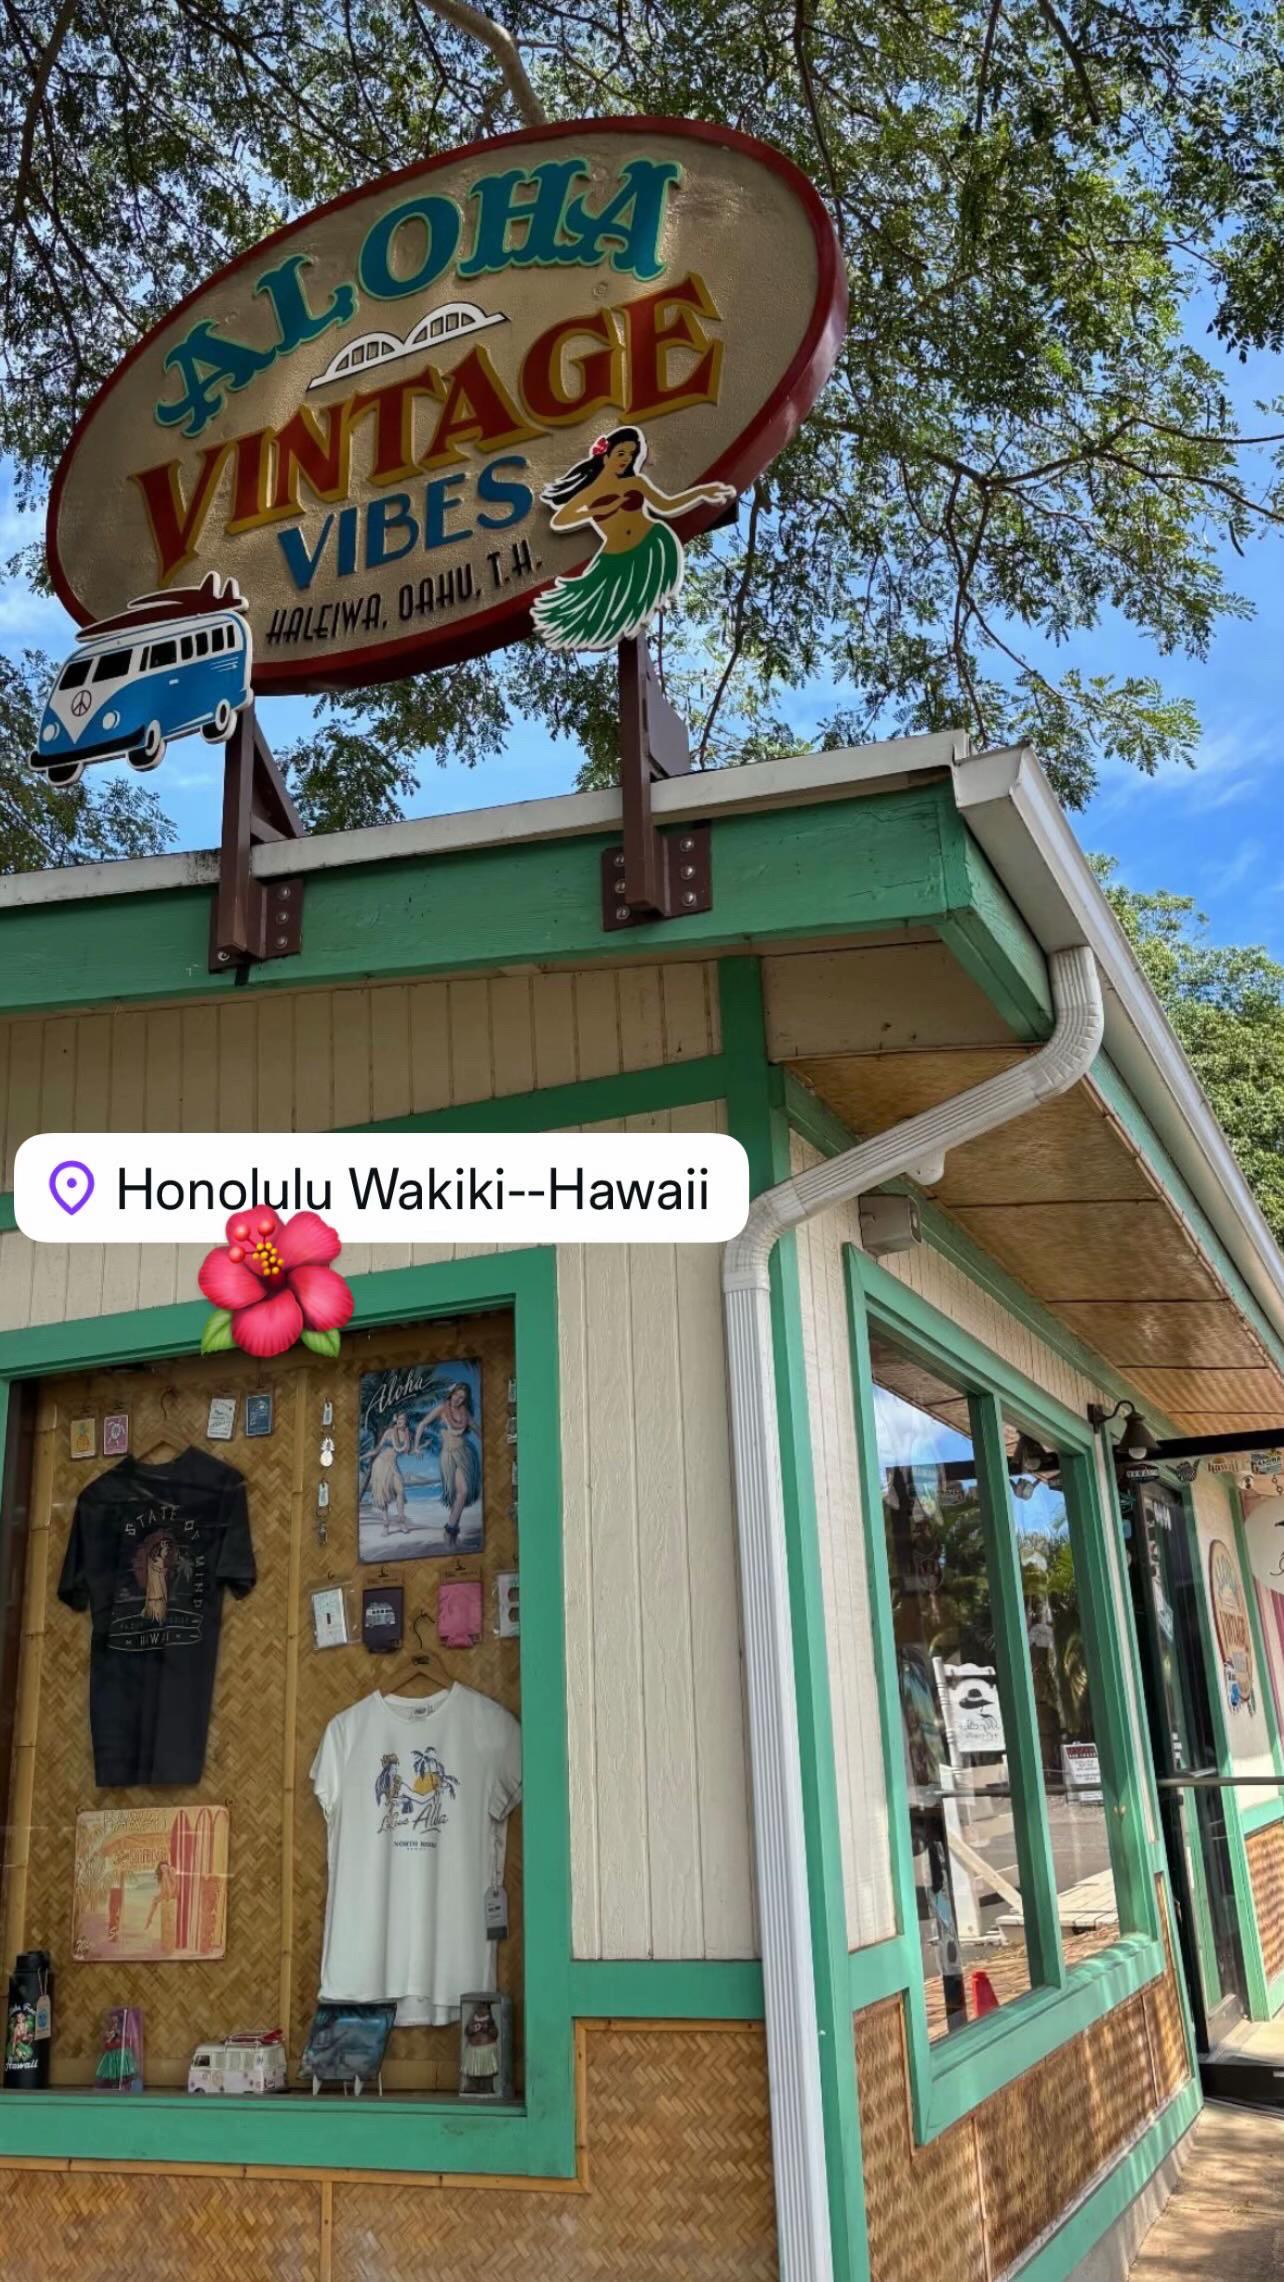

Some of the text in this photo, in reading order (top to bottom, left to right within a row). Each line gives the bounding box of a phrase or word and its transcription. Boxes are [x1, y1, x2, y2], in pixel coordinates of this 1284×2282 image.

[154, 157, 686, 436] ALOHA
[128, 271, 726, 588] VINTAGE
[278, 454, 536, 590] VIBES
[265, 538, 543, 645] HALEIWA, OAHU, T.H.
[365, 1367, 433, 1419] Aloha
[125, 1503, 181, 1537] STATE
